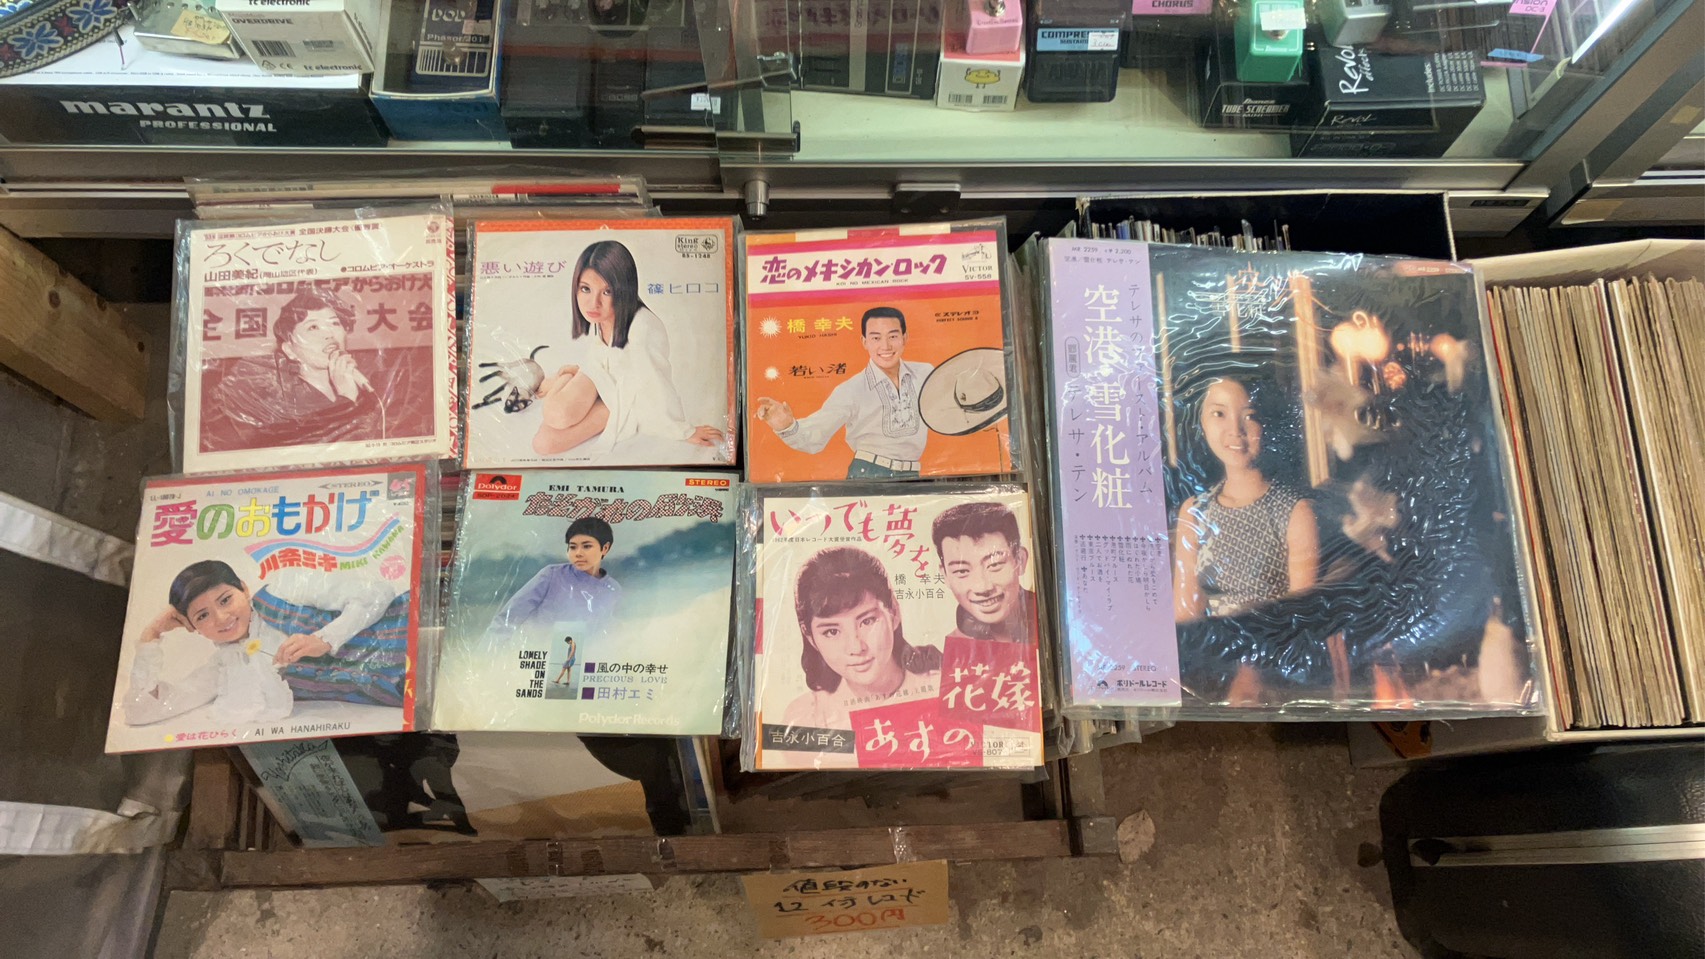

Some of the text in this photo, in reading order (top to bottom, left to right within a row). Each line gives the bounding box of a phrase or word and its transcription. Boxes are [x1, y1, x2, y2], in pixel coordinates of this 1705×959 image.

[59, 100, 270, 119] marantz
[1222, 105, 1243, 113] TUBE
[139, 120, 277, 132] PROFESSIONAL
[204, 239, 342, 268] ろくでなし
[481, 261, 567, 275] 悪い遊び
[962, 265, 993, 274] VICTOR
[647, 282, 719, 294] 篠ヒロコ
[789, 363, 847, 377] 若い渚
[1066, 385, 1088, 502] テレサ・テン
[238, 486, 279, 495] OMOKAGE
[478, 482, 518, 491] Polydor
[577, 485, 625, 493] TAMURA
[150, 490, 380, 547] 愛のおもかげ
[770, 499, 930, 578] いつでも夢を
[259, 548, 338, 580] 川奈ミキ
[894, 587, 946, 599] 吉永小百合
[518, 650, 548, 660] LONELY
[520, 660, 546, 669] SHADE
[596, 662, 669, 674] 風の中の幸せ
[534, 670, 545, 679] ON
[582, 675, 667, 684] PRECIOUS LOVE
[529, 680, 543, 689] THE
[942, 660, 1035, 712] 花嫁
[516, 689, 543, 698] SANDS
[597, 687, 654, 700] 田村エミ
[578, 712, 632, 726] Polydor
[175, 722, 351, 742] 愛は花ひらく AI WA HANAHIRAKU
[769, 729, 846, 747] 吉永小百合
[864, 718, 973, 763] あすの
